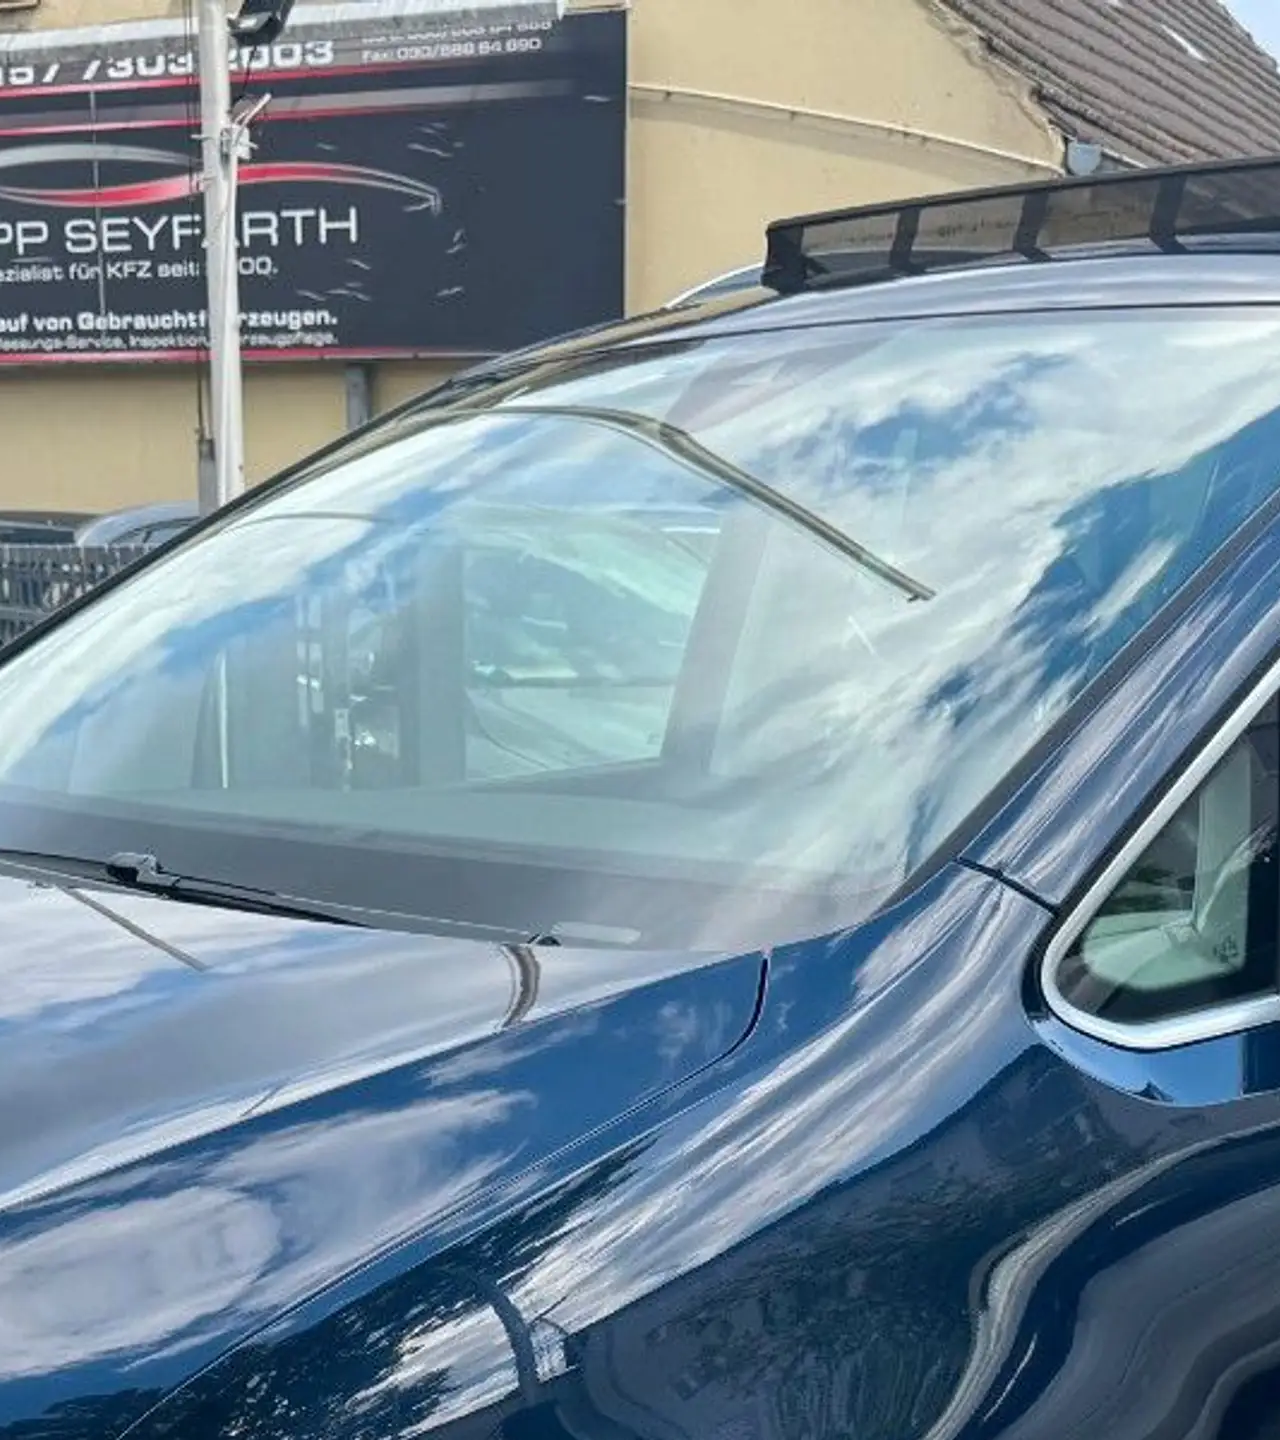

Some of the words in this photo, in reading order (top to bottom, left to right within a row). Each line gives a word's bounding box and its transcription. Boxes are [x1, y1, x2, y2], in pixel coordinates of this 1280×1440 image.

[63, 205, 359, 253] SEYFRTH
[68, 261, 101, 280] für
[106, 259, 153, 279] KFZ
[32, 315, 73, 332] von
[76, 308, 338, 331] Gebrauchtfrzeugen.
